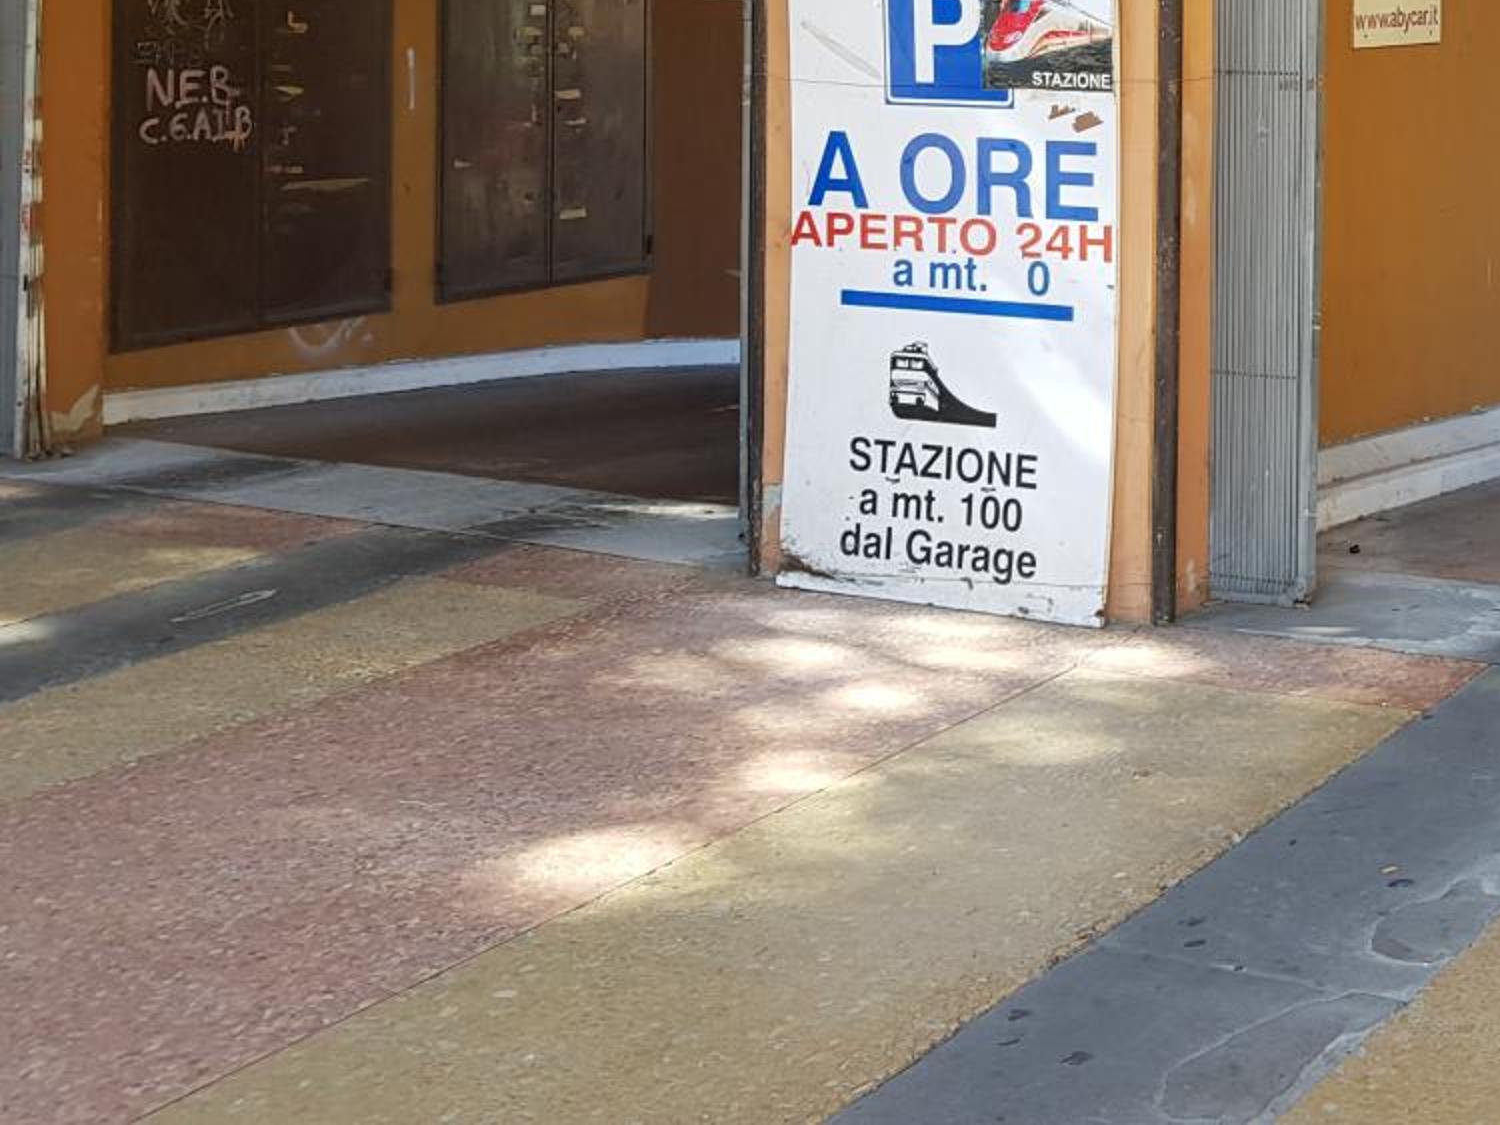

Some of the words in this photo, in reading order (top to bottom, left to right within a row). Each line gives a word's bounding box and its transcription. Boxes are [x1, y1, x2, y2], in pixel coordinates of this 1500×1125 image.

[1032, 70, 1111, 90] STAZIONE
[807, 129, 869, 210] A
[899, 132, 1099, 222] ORE
[790, 211, 998, 256] APERTO
[1016, 222, 1114, 264] 24H
[892, 258, 913, 288] a
[928, 256, 988, 292] mt.
[1027, 260, 1050, 297] 0
[849, 436, 1038, 489] STAZIONE
[858, 488, 879, 517] a
[891, 488, 945, 523] mt.
[960, 494, 1023, 532] 100
[840, 523, 893, 563] dal
[906, 530, 1037, 585] Garage
